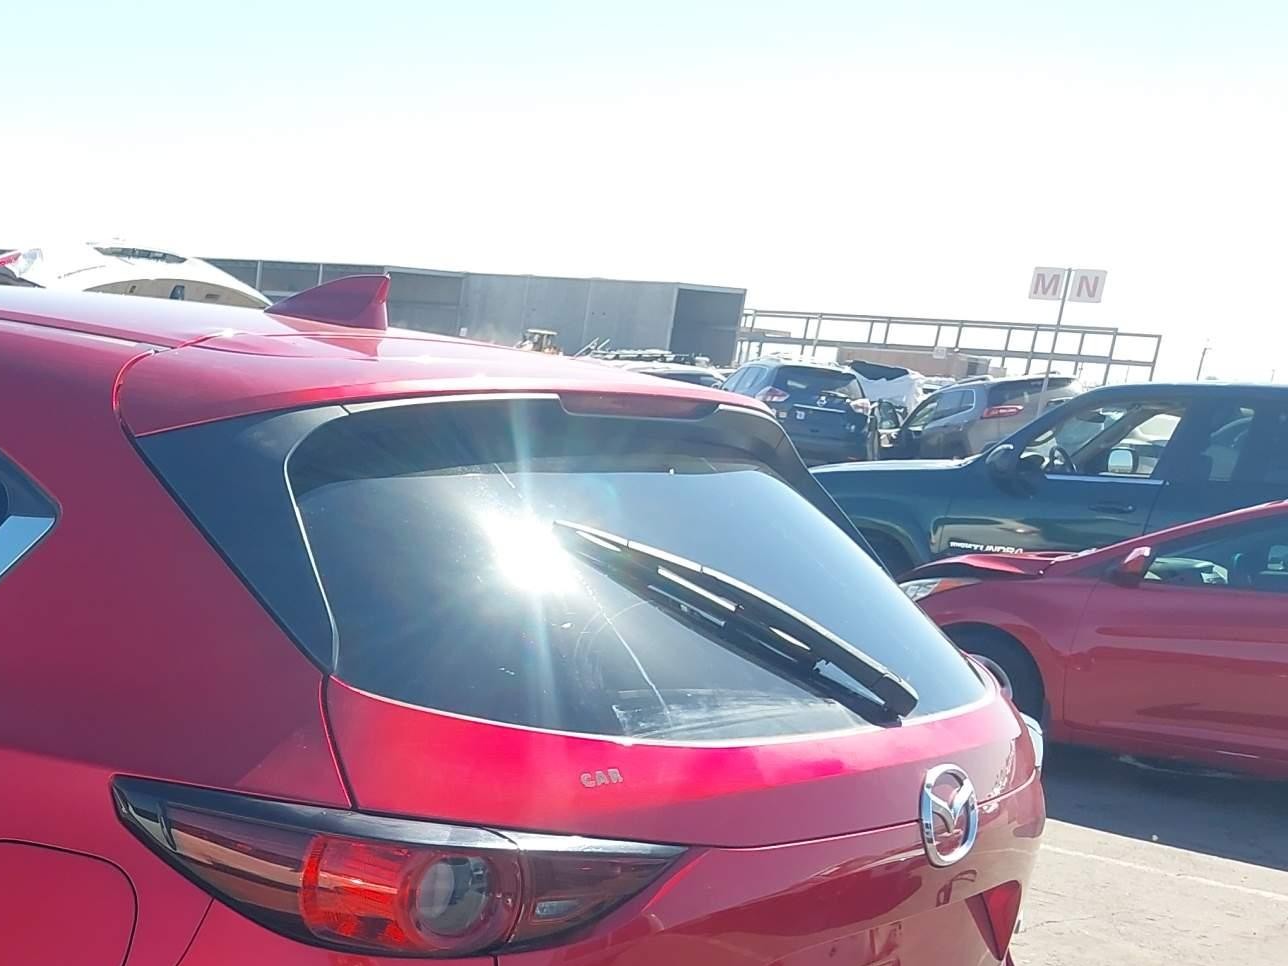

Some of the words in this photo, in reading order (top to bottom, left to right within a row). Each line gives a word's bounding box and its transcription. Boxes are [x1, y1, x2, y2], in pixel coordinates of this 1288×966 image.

[1033, 273, 1061, 296] M
[1076, 275, 1100, 298] N
[972, 543, 1024, 555] TUNDRA
[580, 768, 623, 788] CAR
